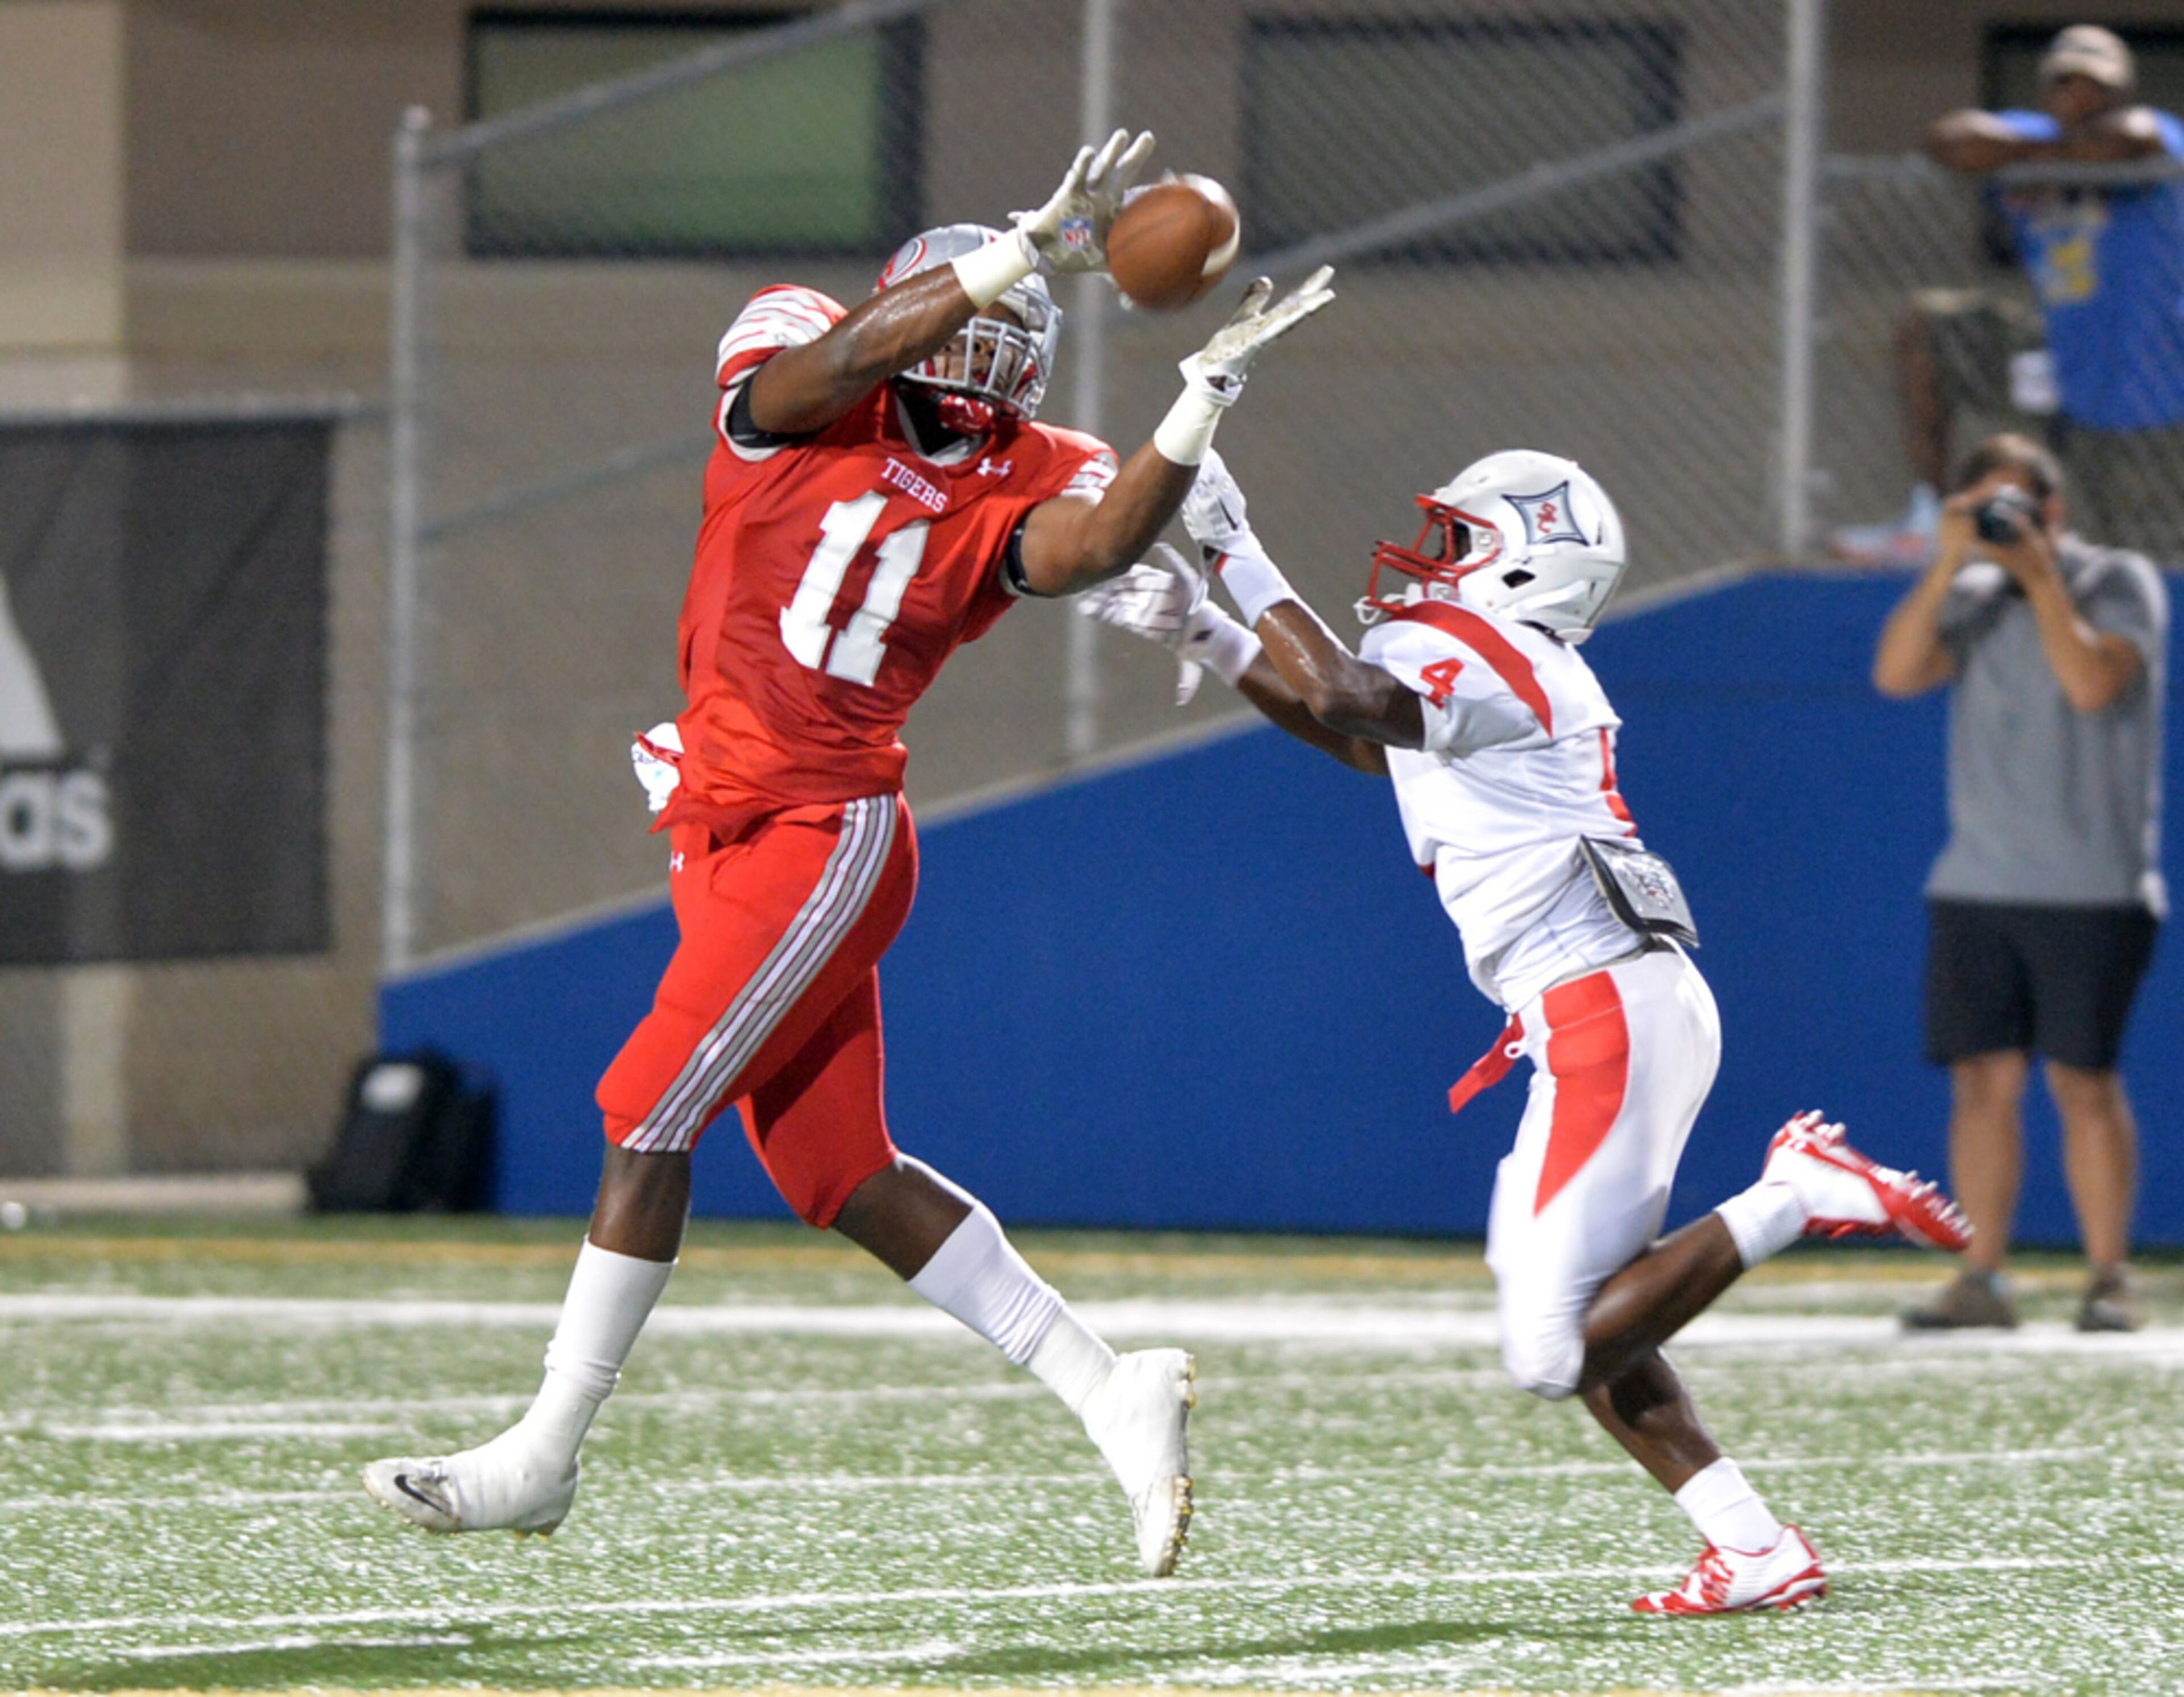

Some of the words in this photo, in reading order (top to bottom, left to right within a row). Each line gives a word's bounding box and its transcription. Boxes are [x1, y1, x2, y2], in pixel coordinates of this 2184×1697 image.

[881, 457, 948, 513] TIGERS
[780, 489, 930, 687] 11
[1420, 657, 1465, 710] 4
